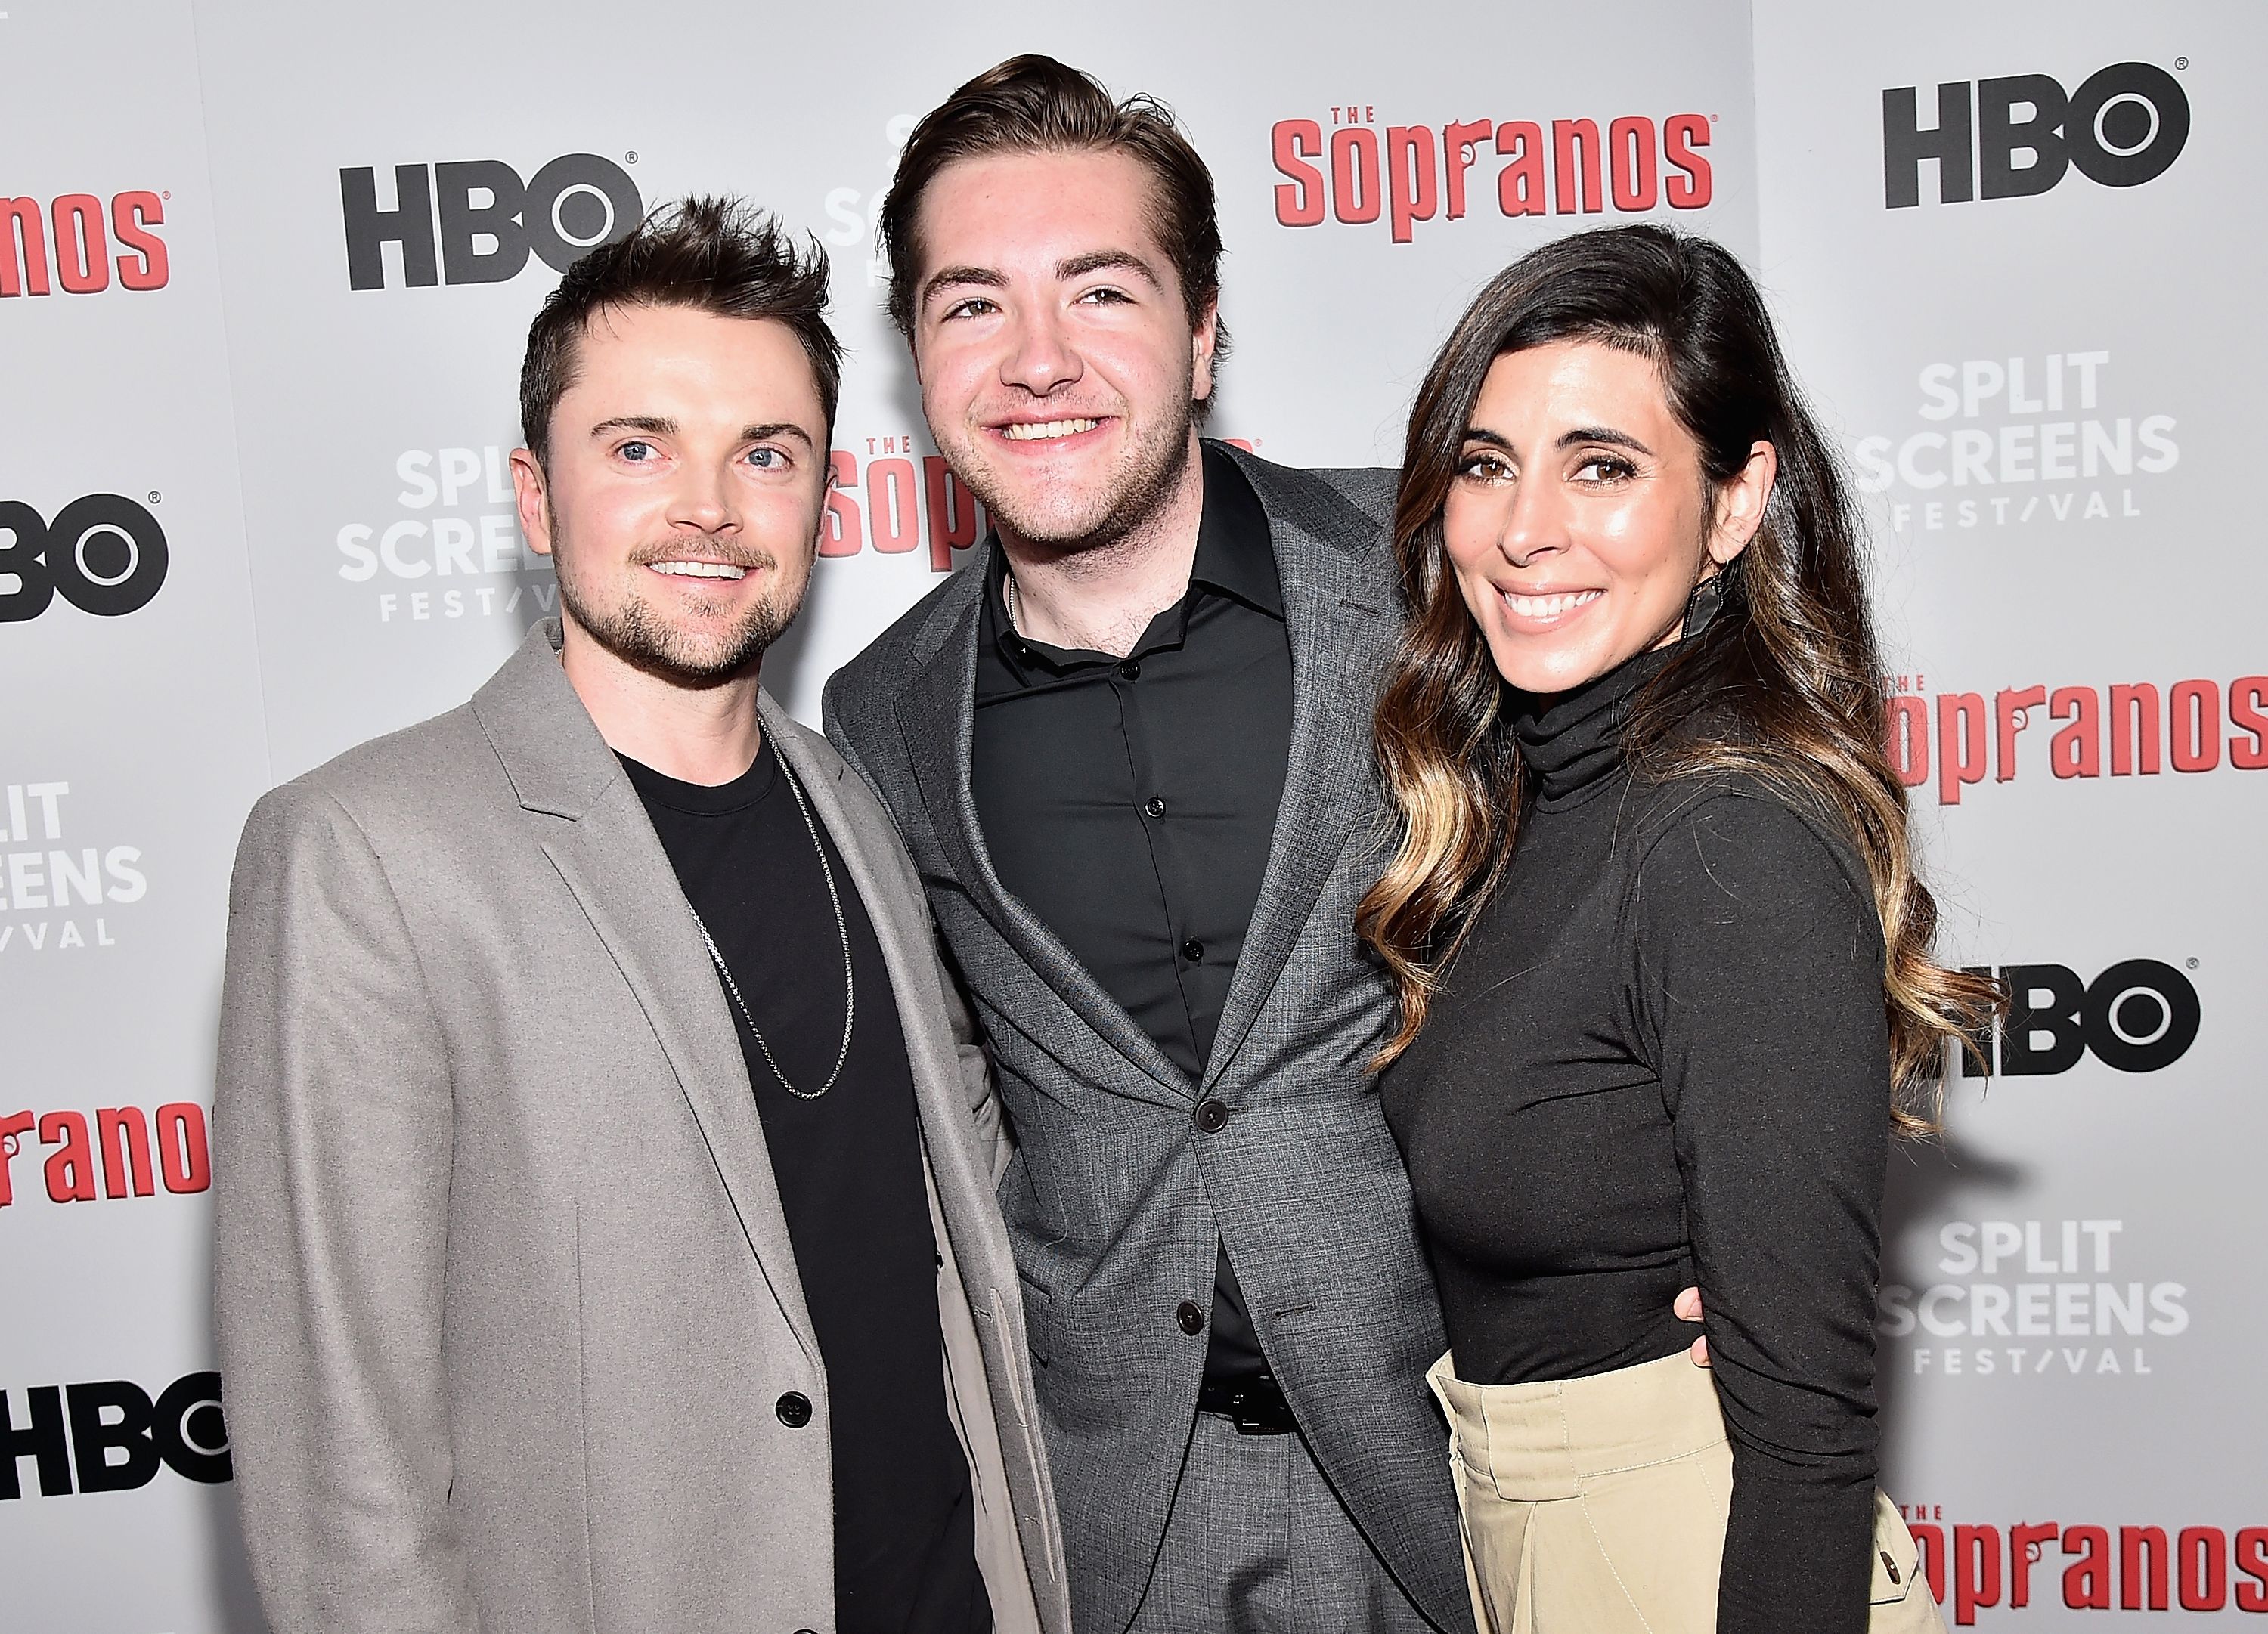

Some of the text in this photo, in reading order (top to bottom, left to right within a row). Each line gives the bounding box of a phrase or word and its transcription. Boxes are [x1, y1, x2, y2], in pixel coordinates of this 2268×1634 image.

[1331, 106, 1374, 124] THE
[1882, 61, 2190, 209] HBO
[1272, 114, 1712, 243] Sopranos
[0, 191, 169, 297] nos
[339, 153, 643, 291] HBO
[1918, 351, 2109, 421] SPLIT
[866, 435, 911, 455] THE
[1854, 414, 2180, 494] SCREENS
[818, 450, 995, 572] Sop
[0, 781, 69, 842] IT
[0, 846, 147, 910] ENS
[0, 1103, 215, 1208] rano
[1938, 1219, 2123, 1275] SPLIT
[1878, 1281, 2189, 1338] SCREENS
[0, 1372, 234, 1500] HBO
[1900, 1505, 1941, 1521] THE
